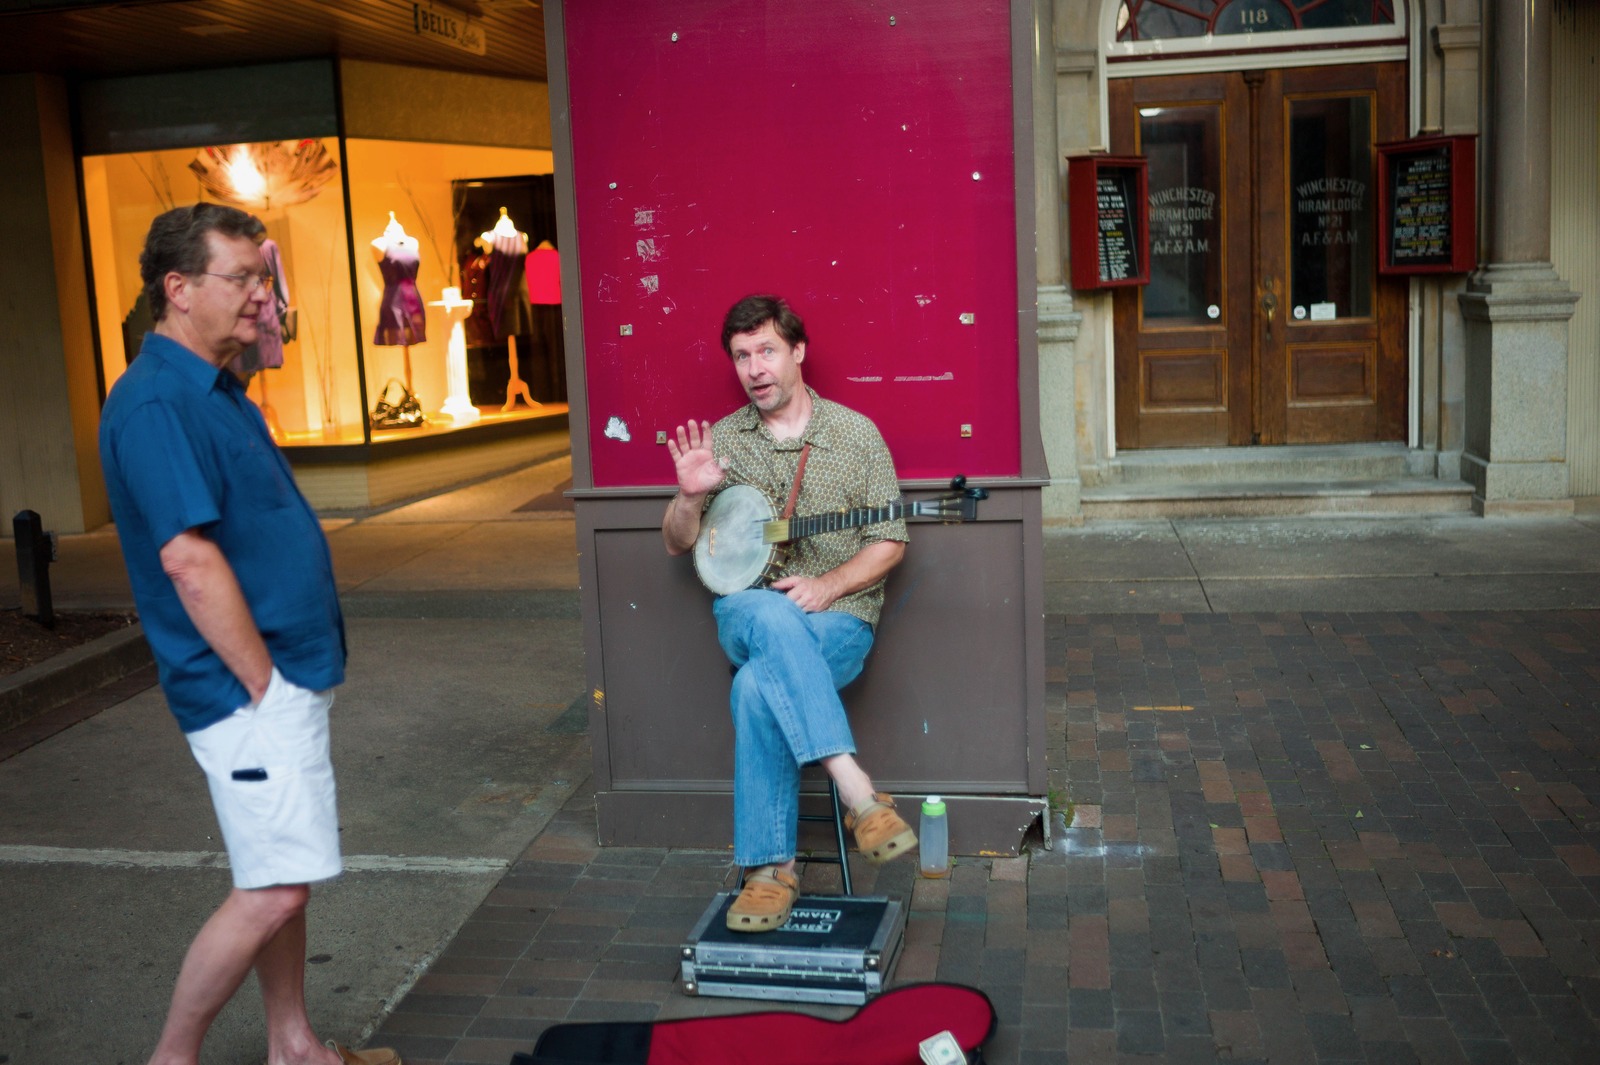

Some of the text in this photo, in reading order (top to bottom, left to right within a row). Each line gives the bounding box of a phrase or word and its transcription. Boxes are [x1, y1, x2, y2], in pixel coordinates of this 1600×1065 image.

[1241, 9, 1268, 24] 118
[1148, 186, 1216, 207] WINCHESTER
[1296, 176, 1366, 200] WINCHESTER
[790, 911, 831, 919] ANVIL
